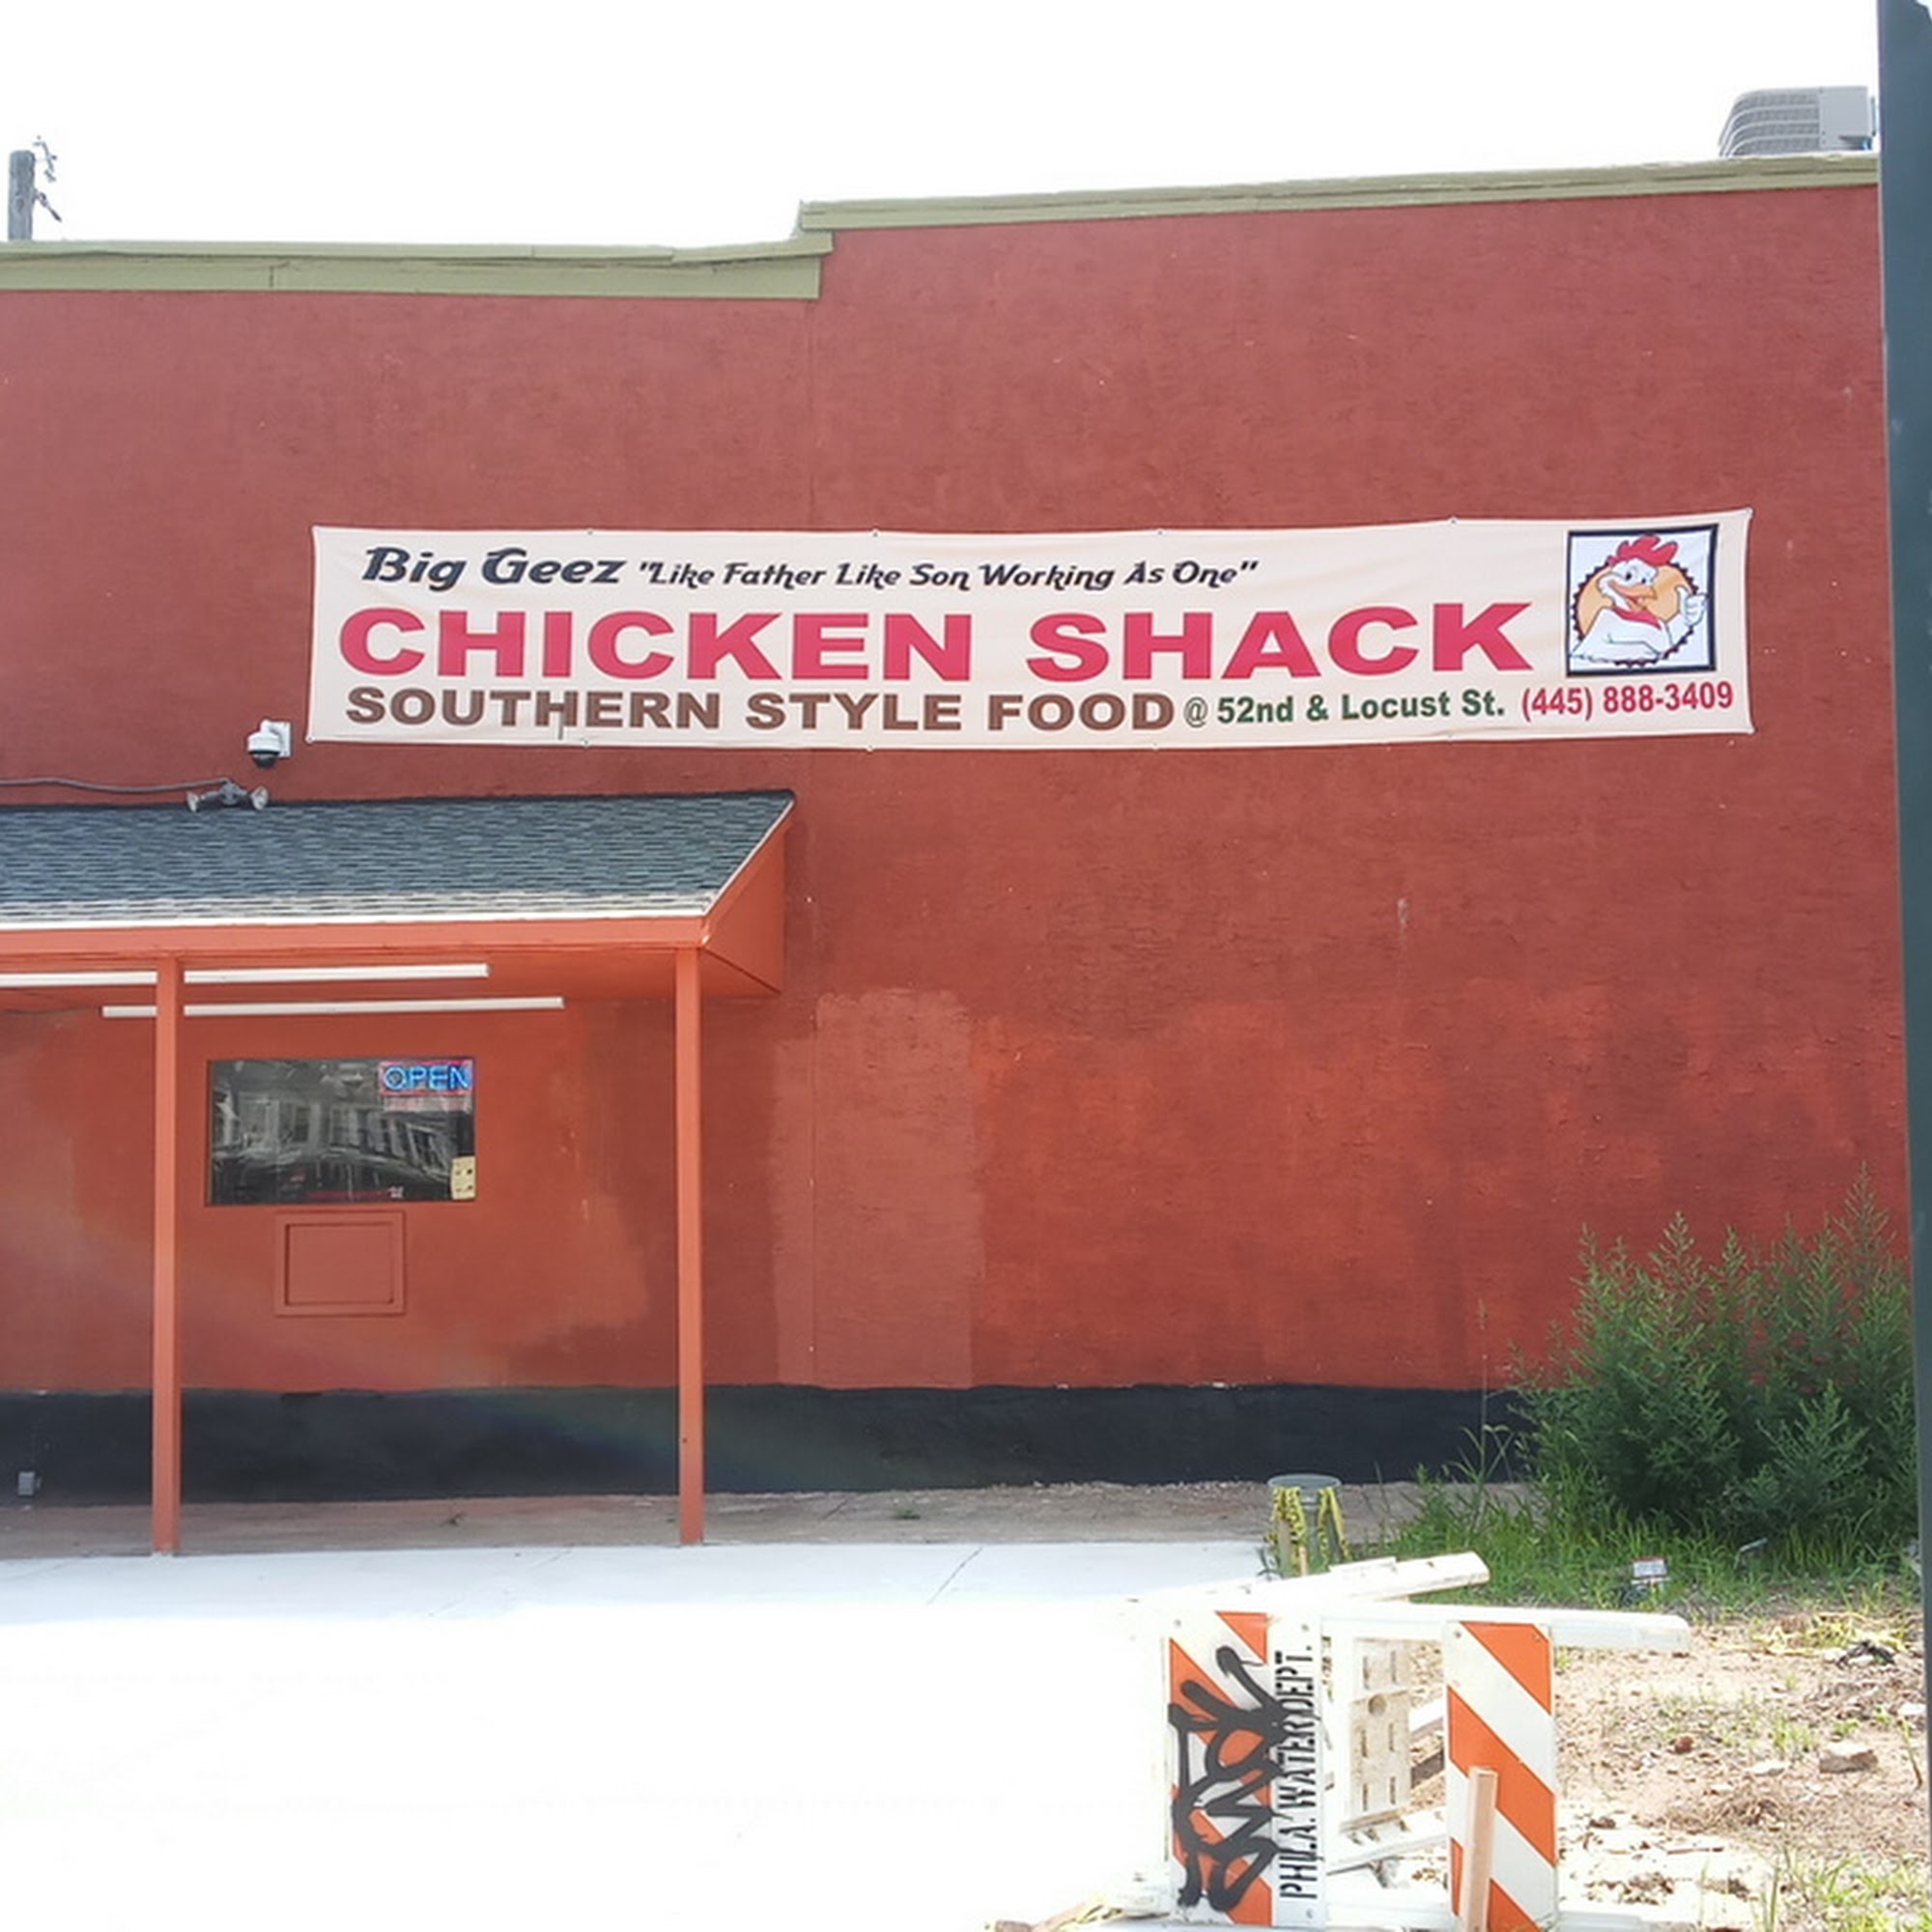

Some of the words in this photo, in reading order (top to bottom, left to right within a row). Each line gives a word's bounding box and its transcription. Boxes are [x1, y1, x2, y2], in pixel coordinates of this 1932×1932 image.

[362, 546, 467, 591] Big
[483, 547, 627, 585] Geez
[639, 561, 715, 588] "Like
[724, 562, 827, 589] Father
[838, 563, 901, 589] Like
[911, 563, 970, 590] Son
[979, 564, 1115, 591] Working
[1123, 560, 1165, 584] As
[1172, 559, 1259, 588] One"
[339, 608, 972, 682] CHICKEN
[1026, 602, 1533, 682] SHACK
[346, 688, 720, 729] SOUTHERN
[746, 693, 962, 731] STYLE
[987, 694, 1176, 731] FOOD
[1183, 697, 1209, 728] @
[1216, 696, 1294, 724] 52nd
[1306, 696, 1330, 721] &
[1341, 692, 1452, 721] Locust
[1462, 689, 1505, 718] St.
[1521, 686, 1594, 722] (445)
[1603, 680, 1734, 714] 888-3409
[383, 1065, 471, 1091] OPEN
[1275, 1717, 1318, 1809] WATER
[1278, 1818, 1318, 1899] PHILA.
